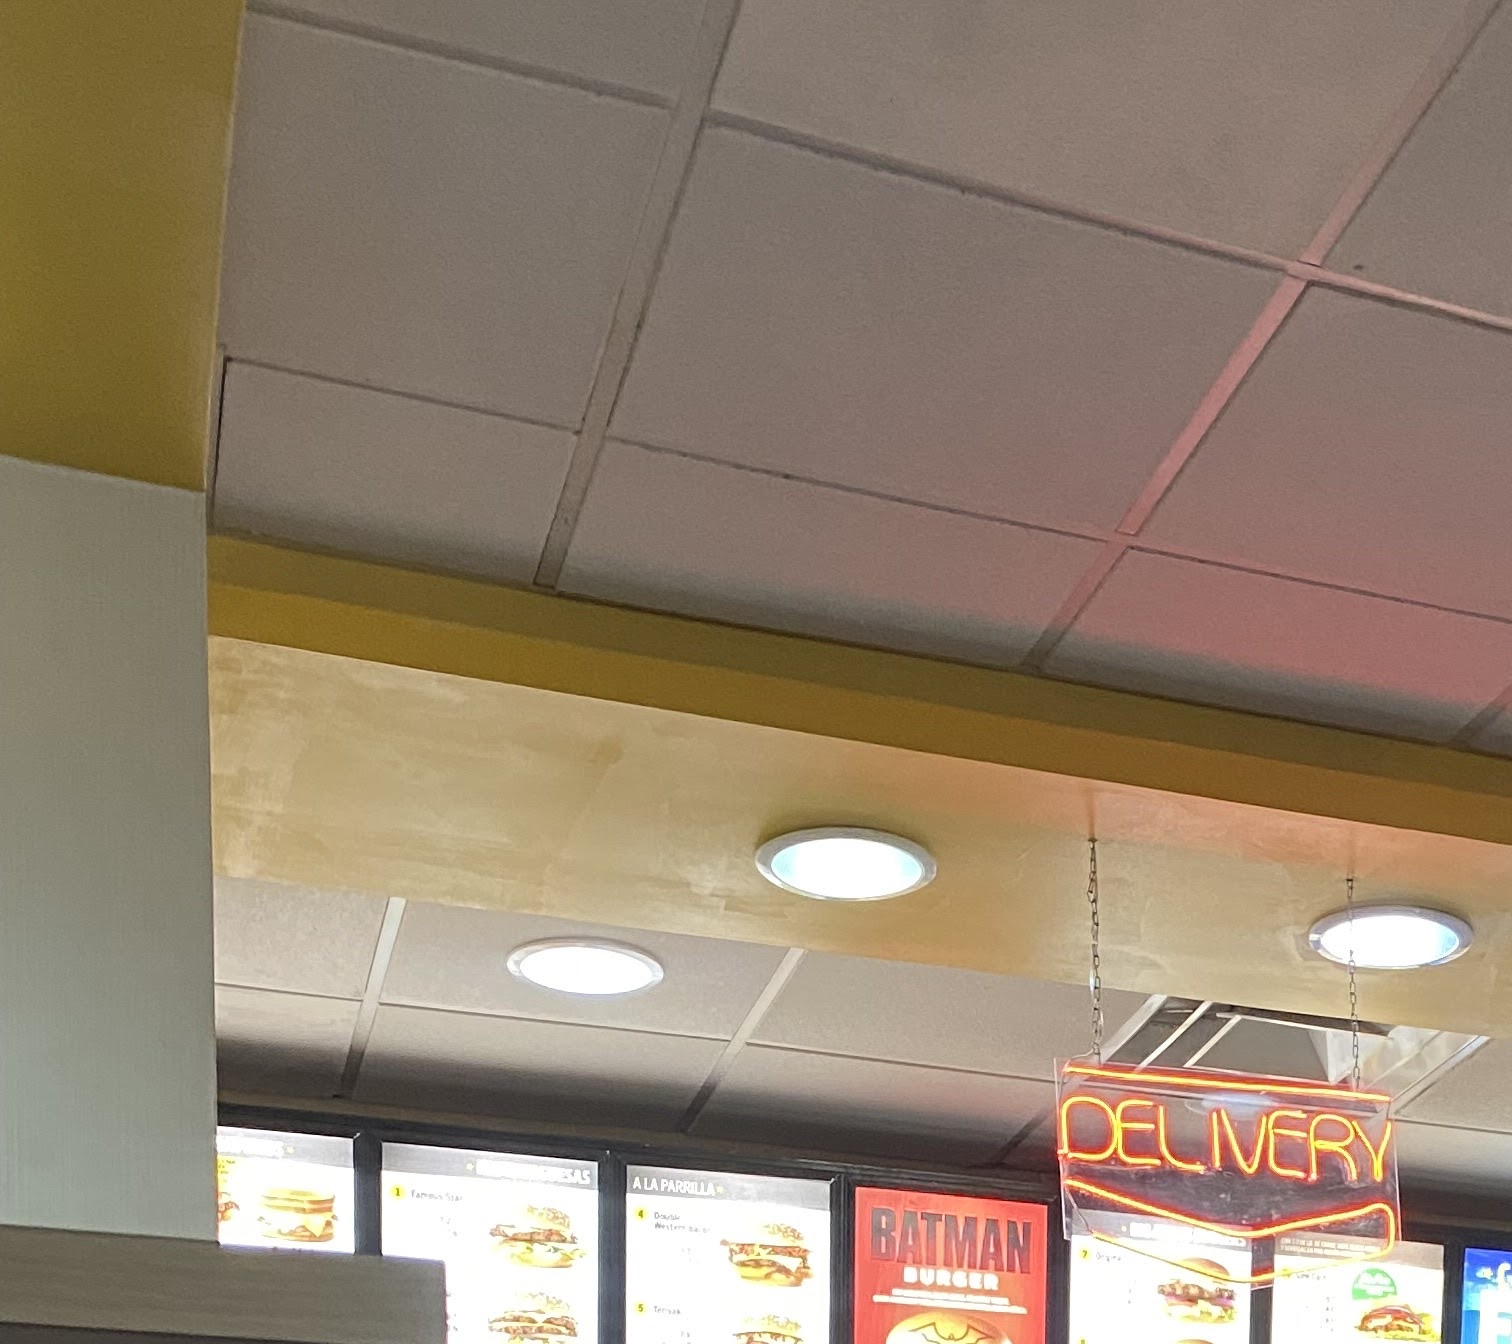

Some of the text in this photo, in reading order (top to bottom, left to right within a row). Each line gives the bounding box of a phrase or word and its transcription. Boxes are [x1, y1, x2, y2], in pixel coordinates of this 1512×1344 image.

[1057, 1095, 1391, 1183] DELIVERY
[633, 1177, 716, 1197] A LA PARRILLA
[870, 1206, 1032, 1274] BATMAN
[903, 1266, 999, 1291] BURGER
